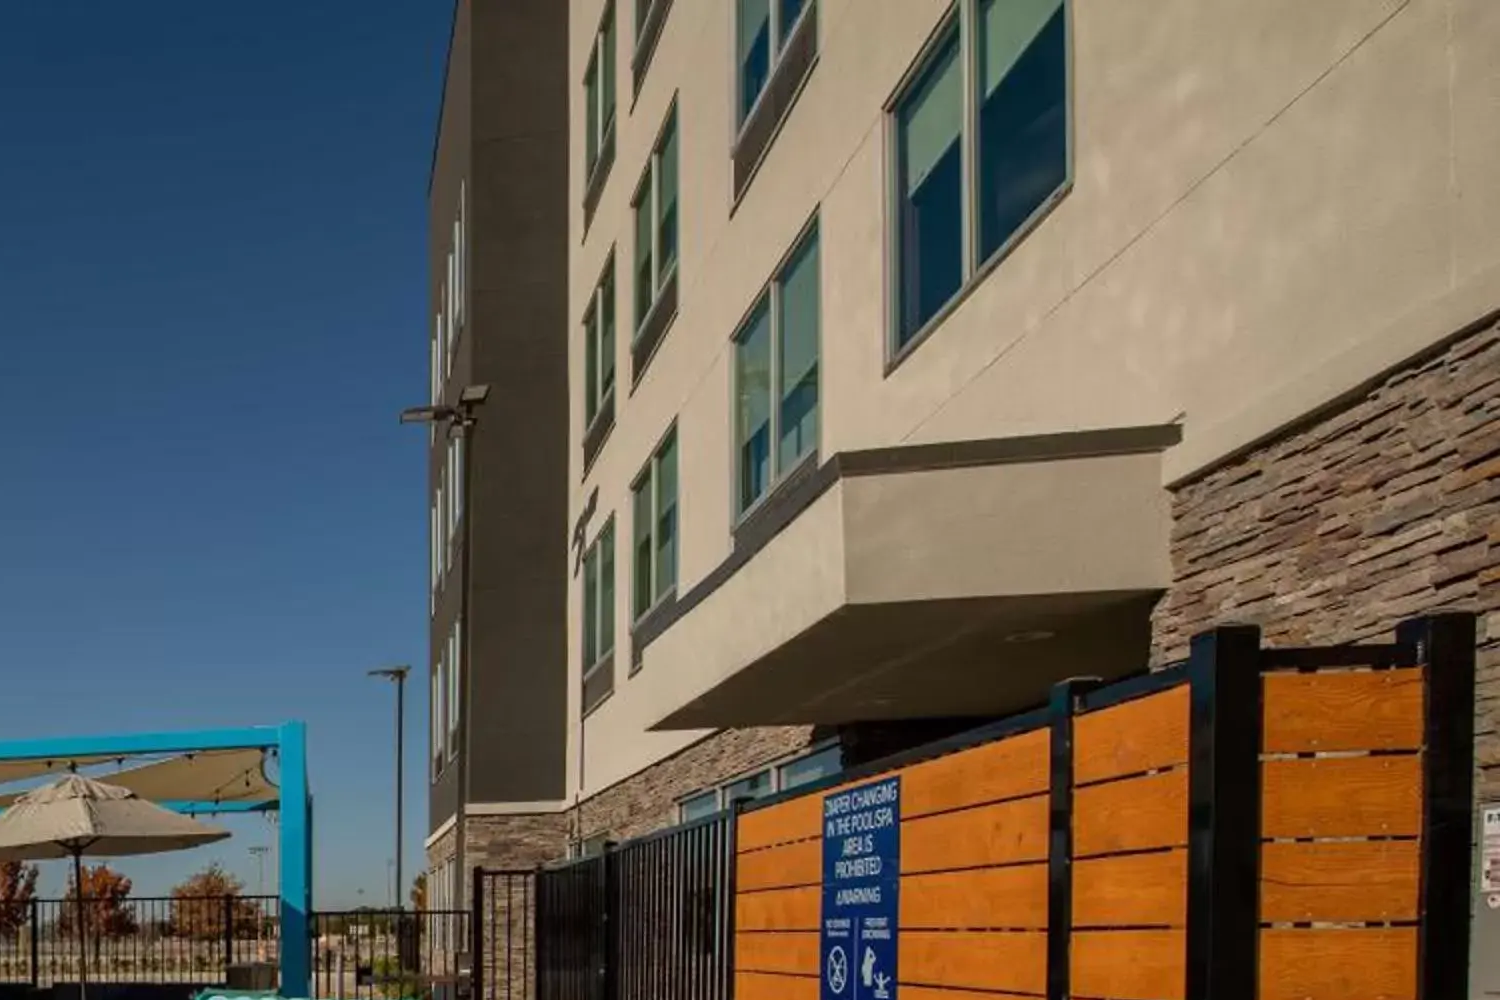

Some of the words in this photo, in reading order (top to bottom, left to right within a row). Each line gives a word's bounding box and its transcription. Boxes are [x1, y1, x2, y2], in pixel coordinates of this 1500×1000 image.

[825, 795, 850, 816] DIAPER
[851, 782, 898, 810] CHANGING
[826, 821, 834, 838] IN
[836, 816, 851, 836] THE
[851, 807, 894, 832] POOL/SPA
[842, 837, 863, 857] AREA
[864, 834, 874, 854] IS
[834, 856, 883, 879] PROHIBITED
[843, 886, 881, 906] WARNING
